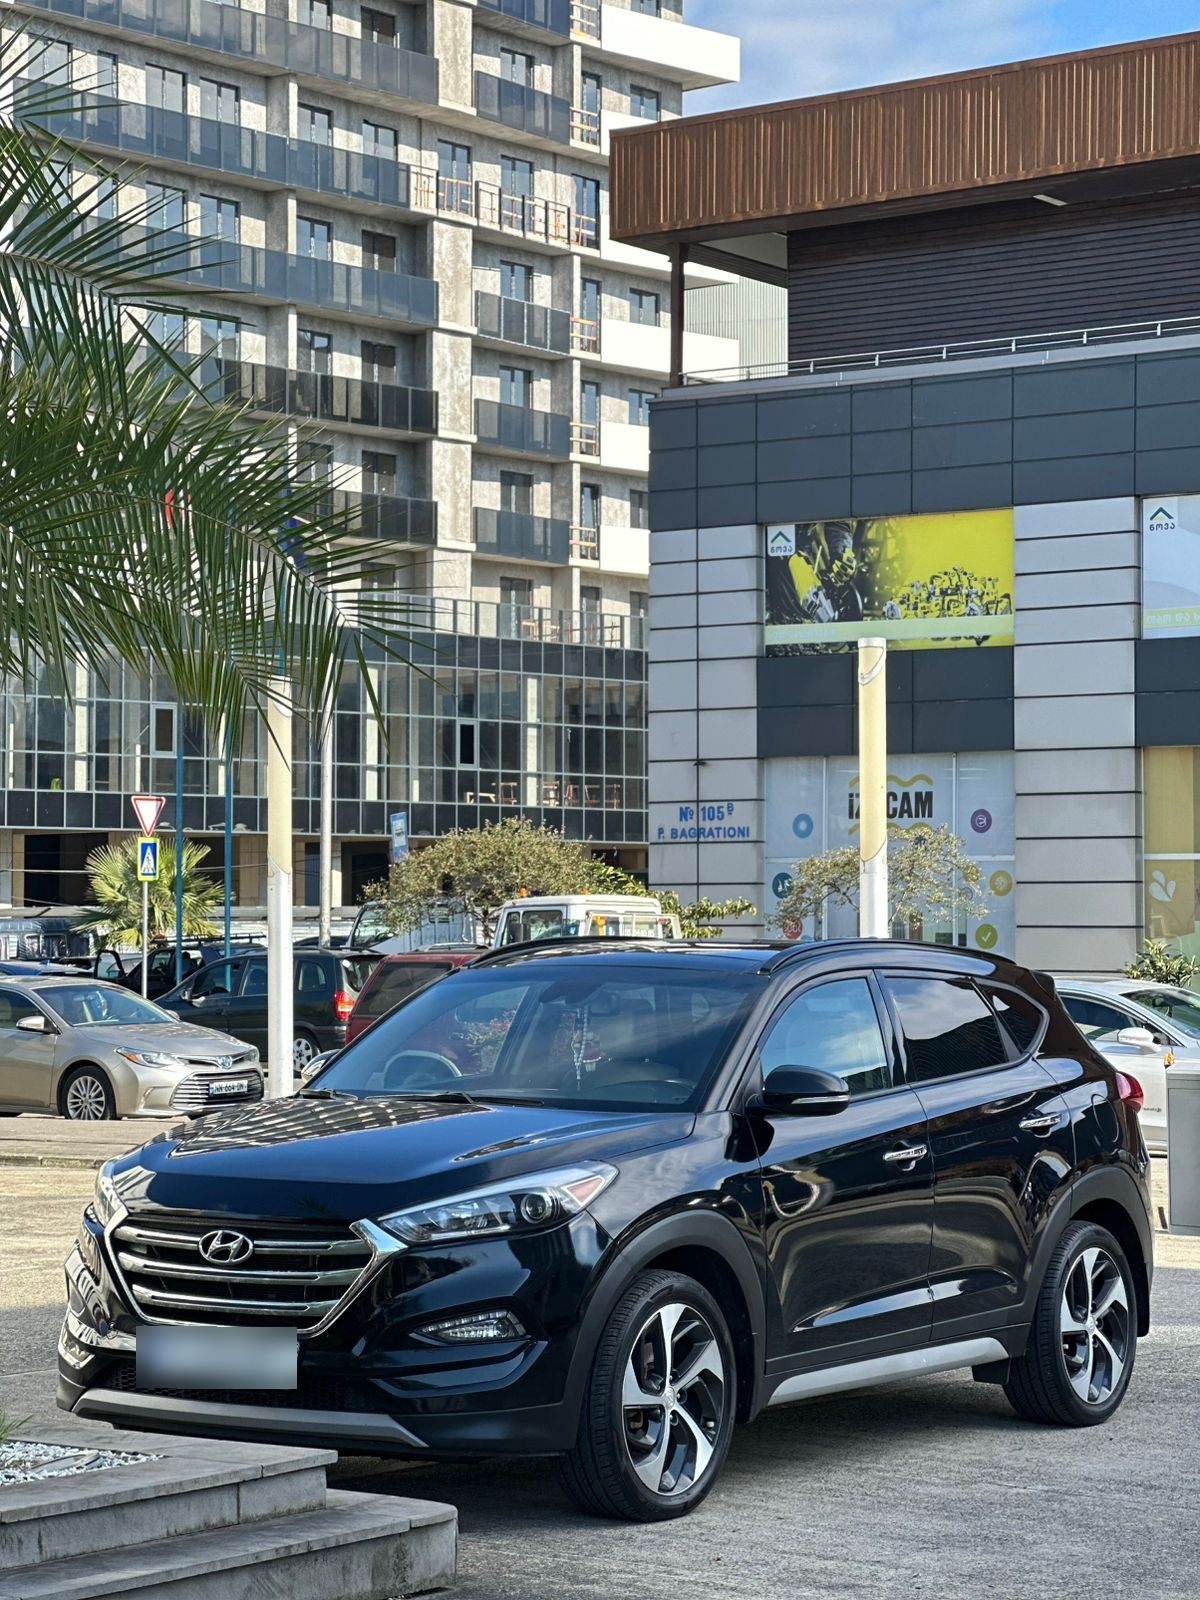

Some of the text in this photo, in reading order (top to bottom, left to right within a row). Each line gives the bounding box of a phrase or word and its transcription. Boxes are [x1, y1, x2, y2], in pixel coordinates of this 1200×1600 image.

[1149, 522, 1175, 532] ნოვა
[770, 545, 793, 554] ნოვა
[848, 791, 934, 819] iCAM
[670, 826, 751, 839] BAGRATIONI
